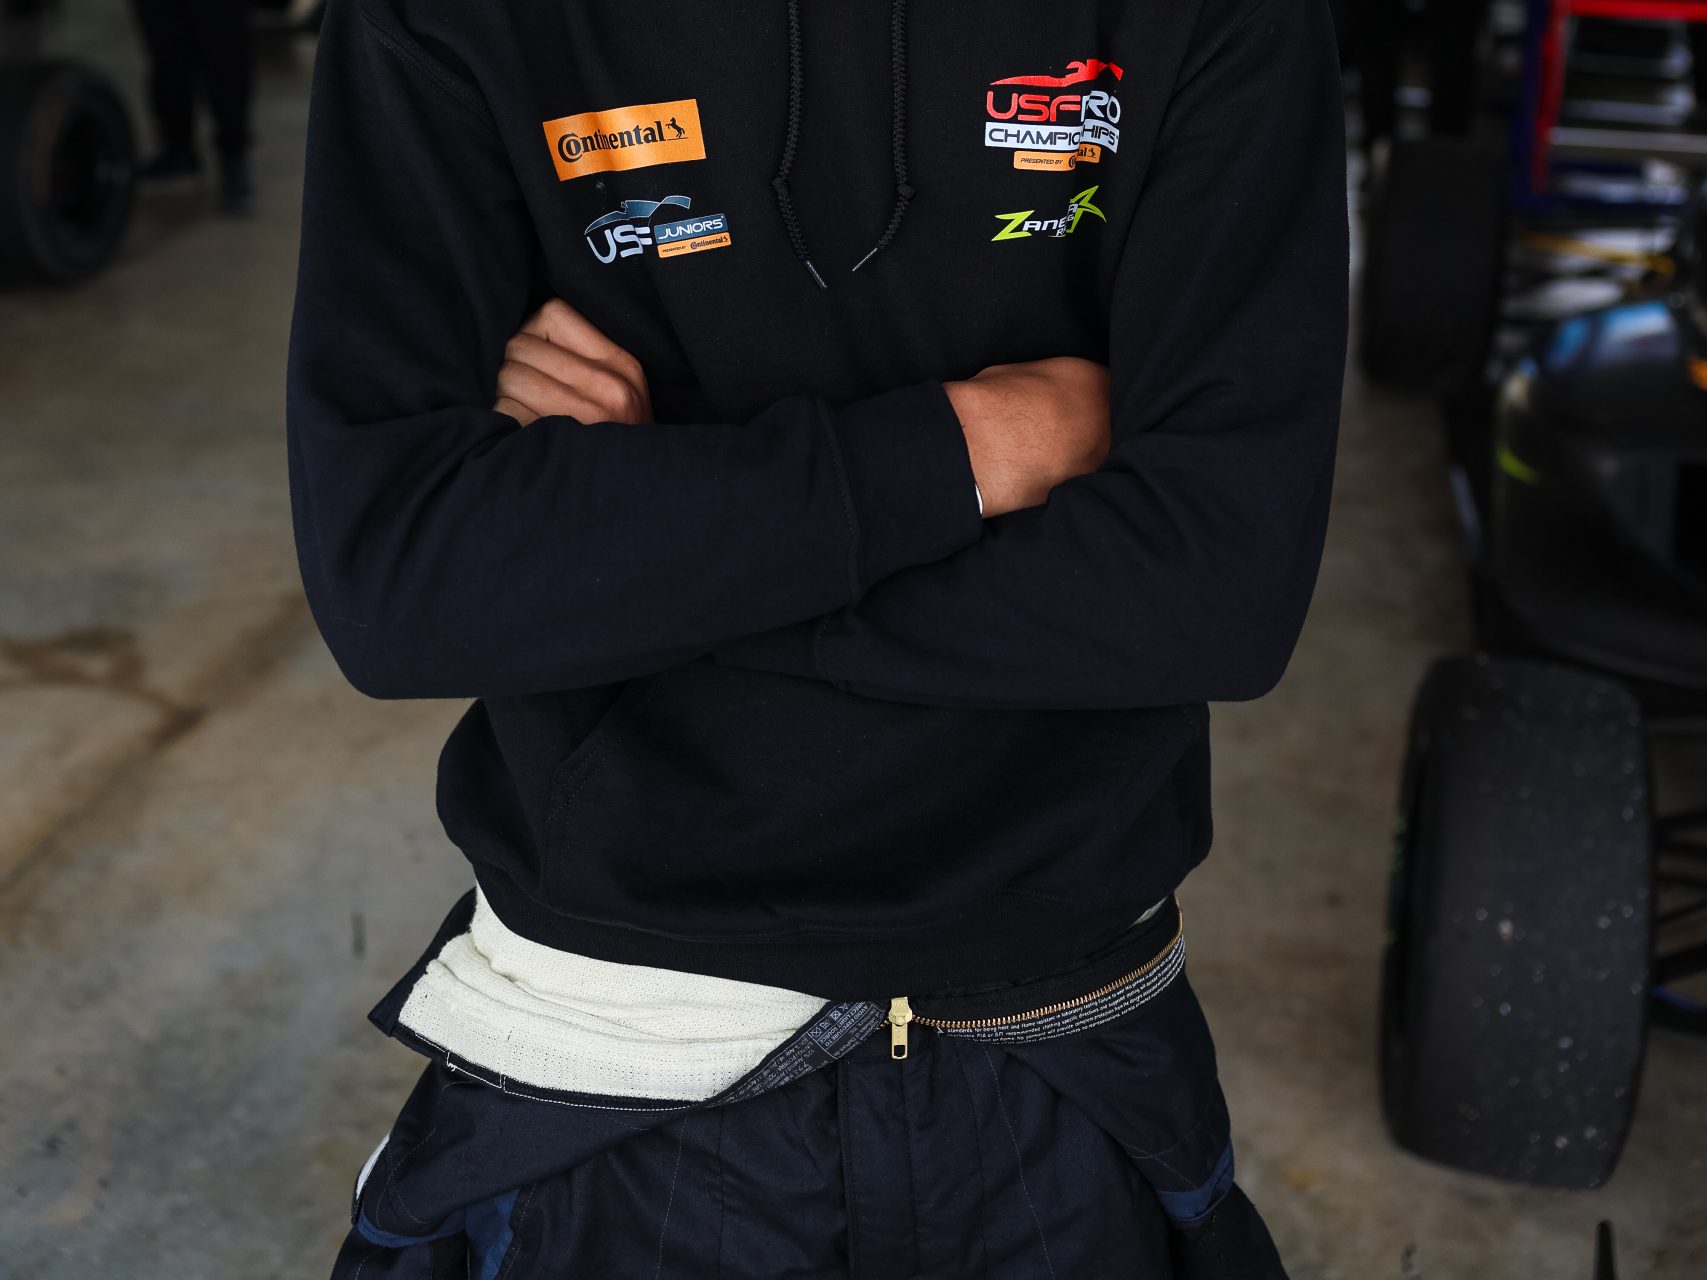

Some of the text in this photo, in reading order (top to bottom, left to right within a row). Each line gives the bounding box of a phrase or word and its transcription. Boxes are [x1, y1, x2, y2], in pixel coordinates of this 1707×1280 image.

[557, 121, 665, 163] Continental
[1020, 157, 1064, 165] PRESENTED BY
[658, 218, 724, 240] JUNIORS
